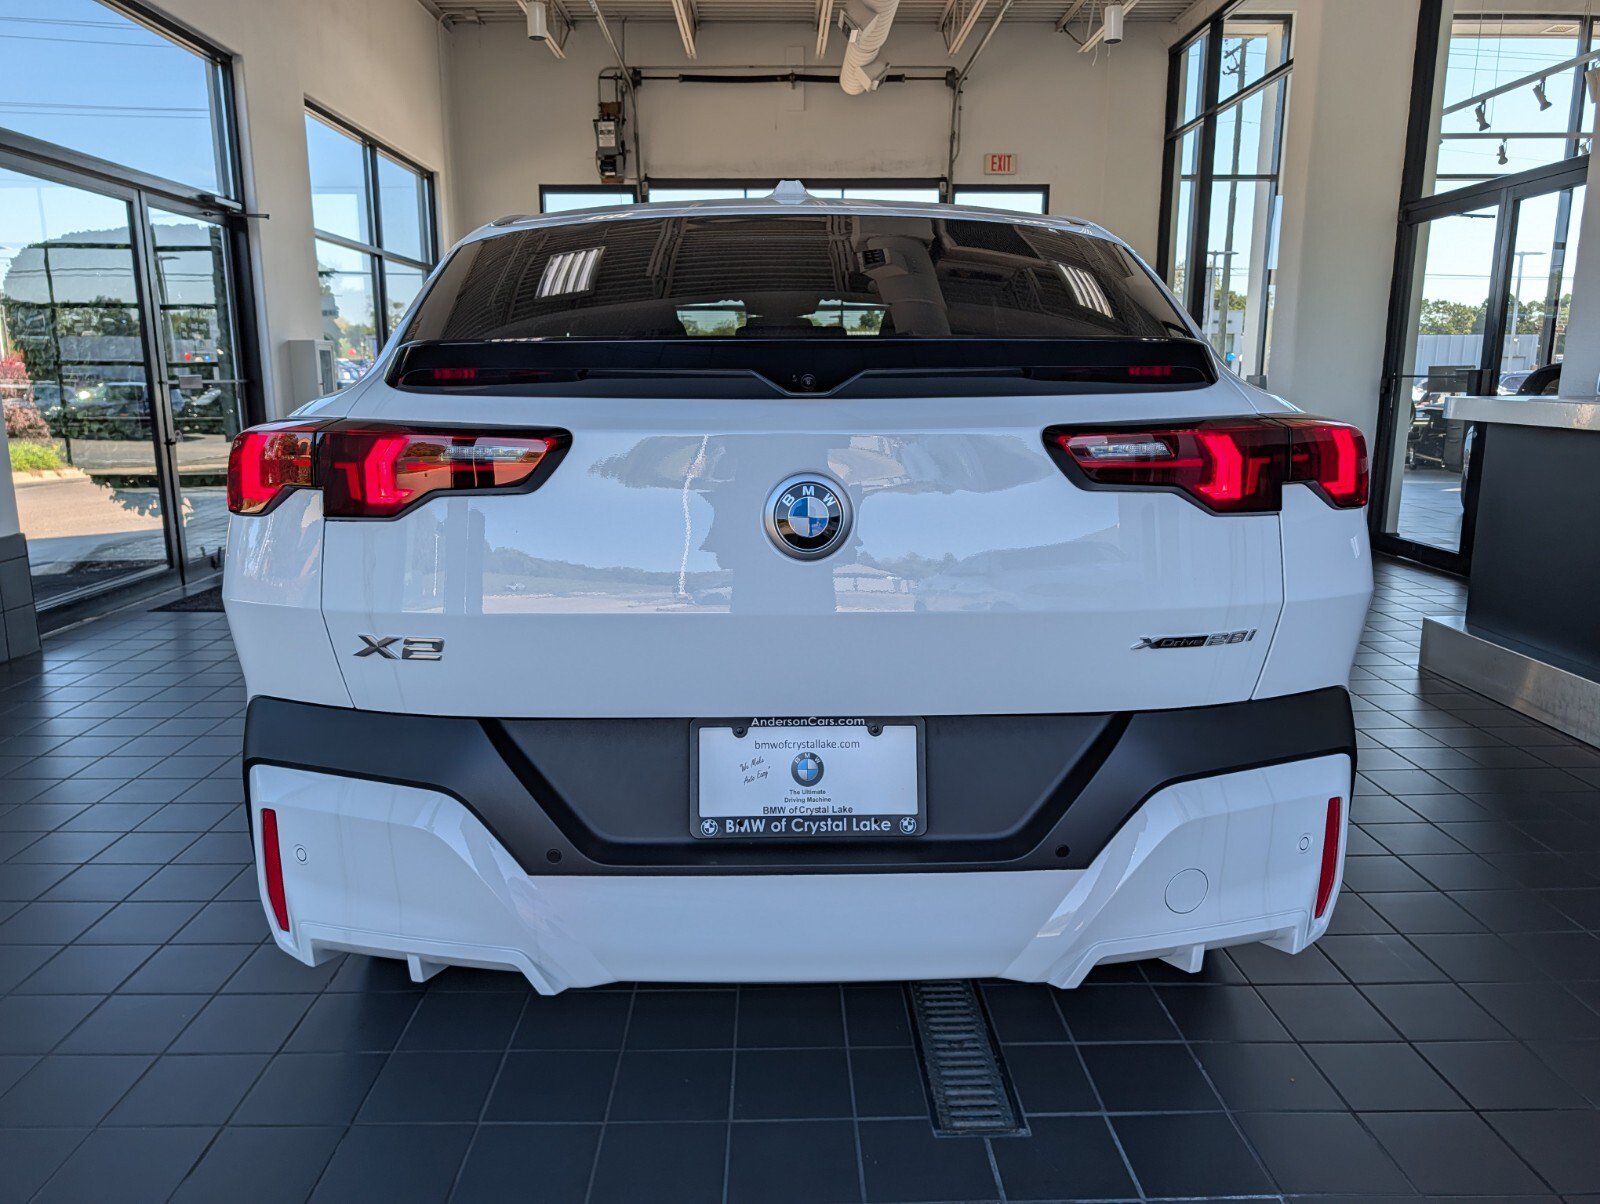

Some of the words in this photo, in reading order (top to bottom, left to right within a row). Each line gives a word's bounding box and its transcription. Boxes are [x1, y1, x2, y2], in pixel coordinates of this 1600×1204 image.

[991, 154, 1012, 172] EXIT
[352, 633, 445, 661] X2
[751, 717, 866, 727] AndersonCars.com
[754, 739, 860, 751] bmwofcrystallake.com
[762, 806, 786, 815] BMW
[788, 806, 798, 814] of
[799, 806, 830, 816] Crystal
[831, 806, 854, 814] Lake
[725, 819, 766, 833] BMW
[770, 818, 787, 833] of
[791, 817, 847, 835] Crystal
[852, 817, 892, 832] Lake
